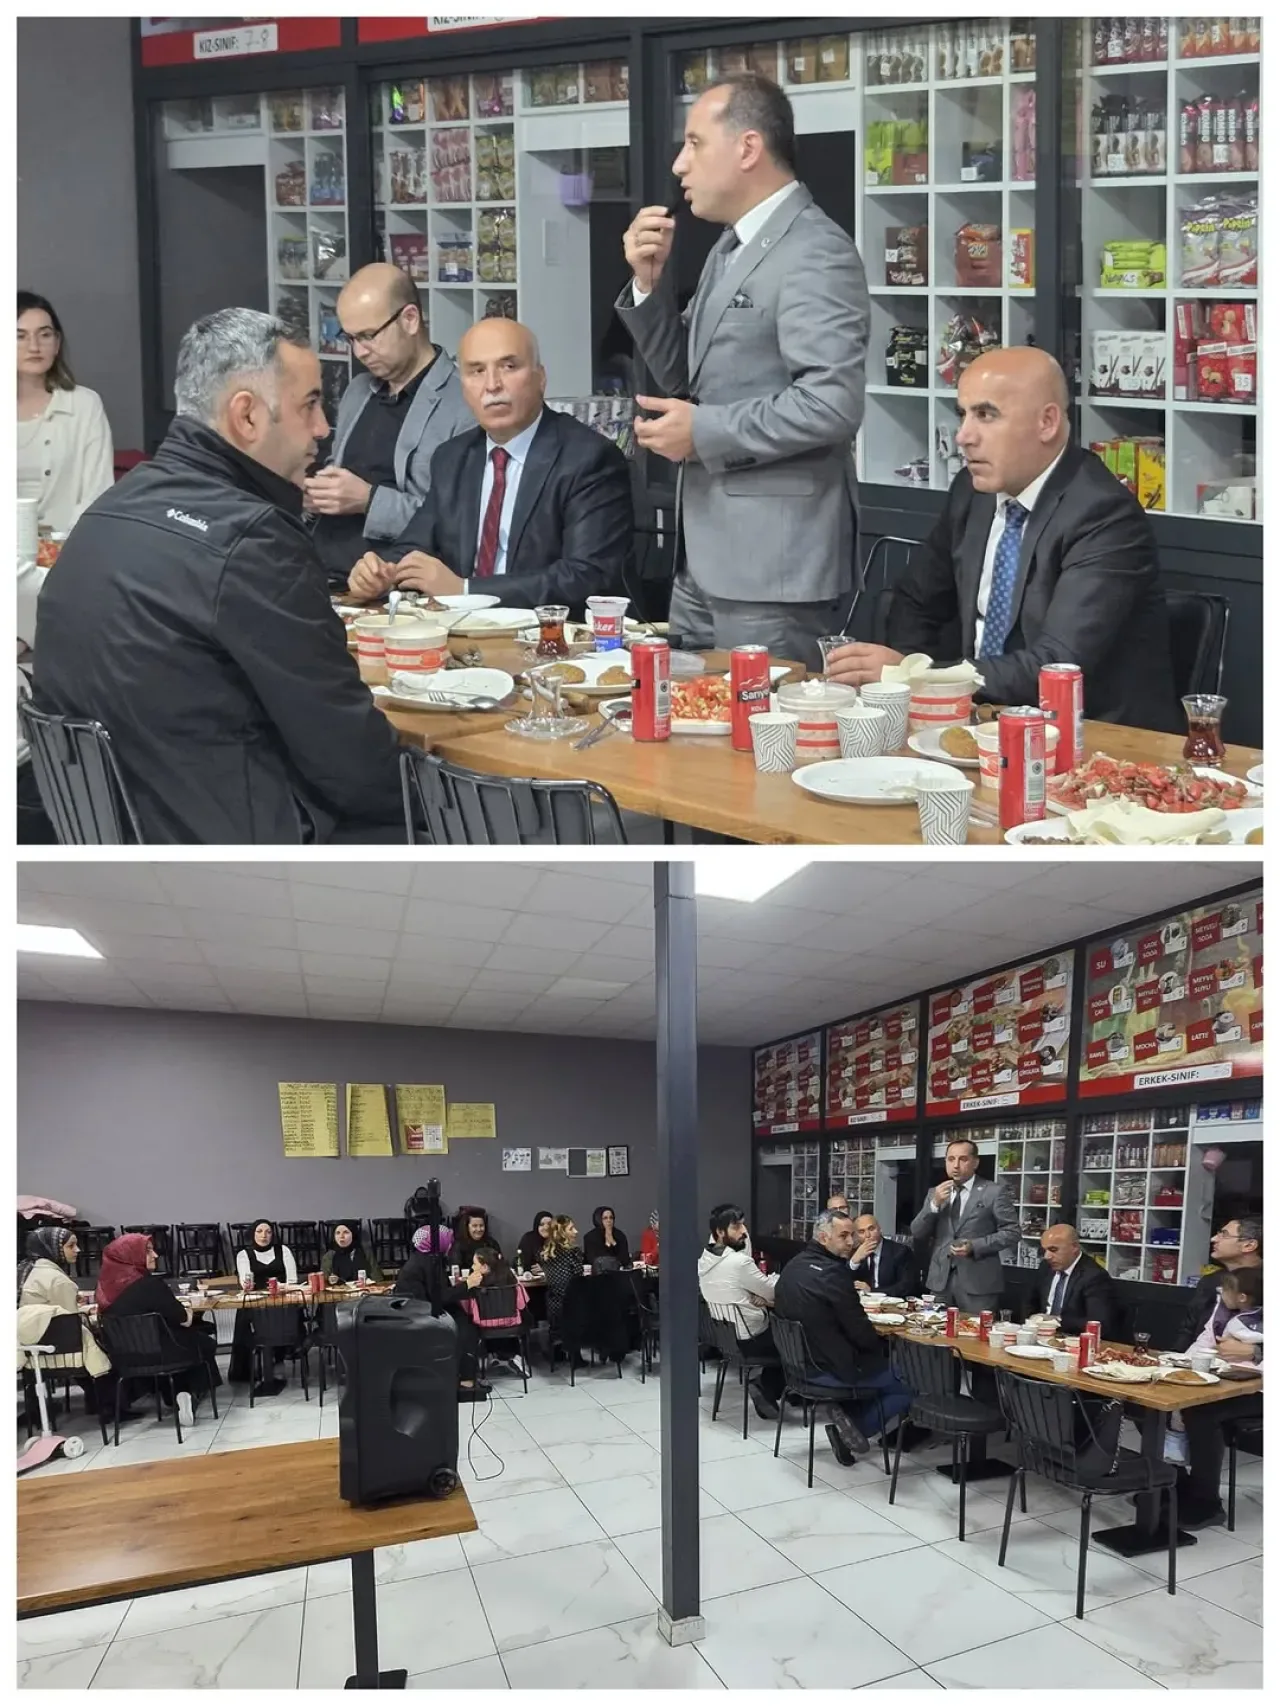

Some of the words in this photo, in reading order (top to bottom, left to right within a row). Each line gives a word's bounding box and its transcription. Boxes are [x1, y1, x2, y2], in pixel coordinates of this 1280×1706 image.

[174, 510, 209, 532] Columbia
[1095, 960, 1107, 970] SU
[1191, 1032, 1209, 1040] LATTE
[1135, 1041, 1156, 1050] MOCHA
[1138, 1070, 1199, 1086] ERKEK-SINIF:
